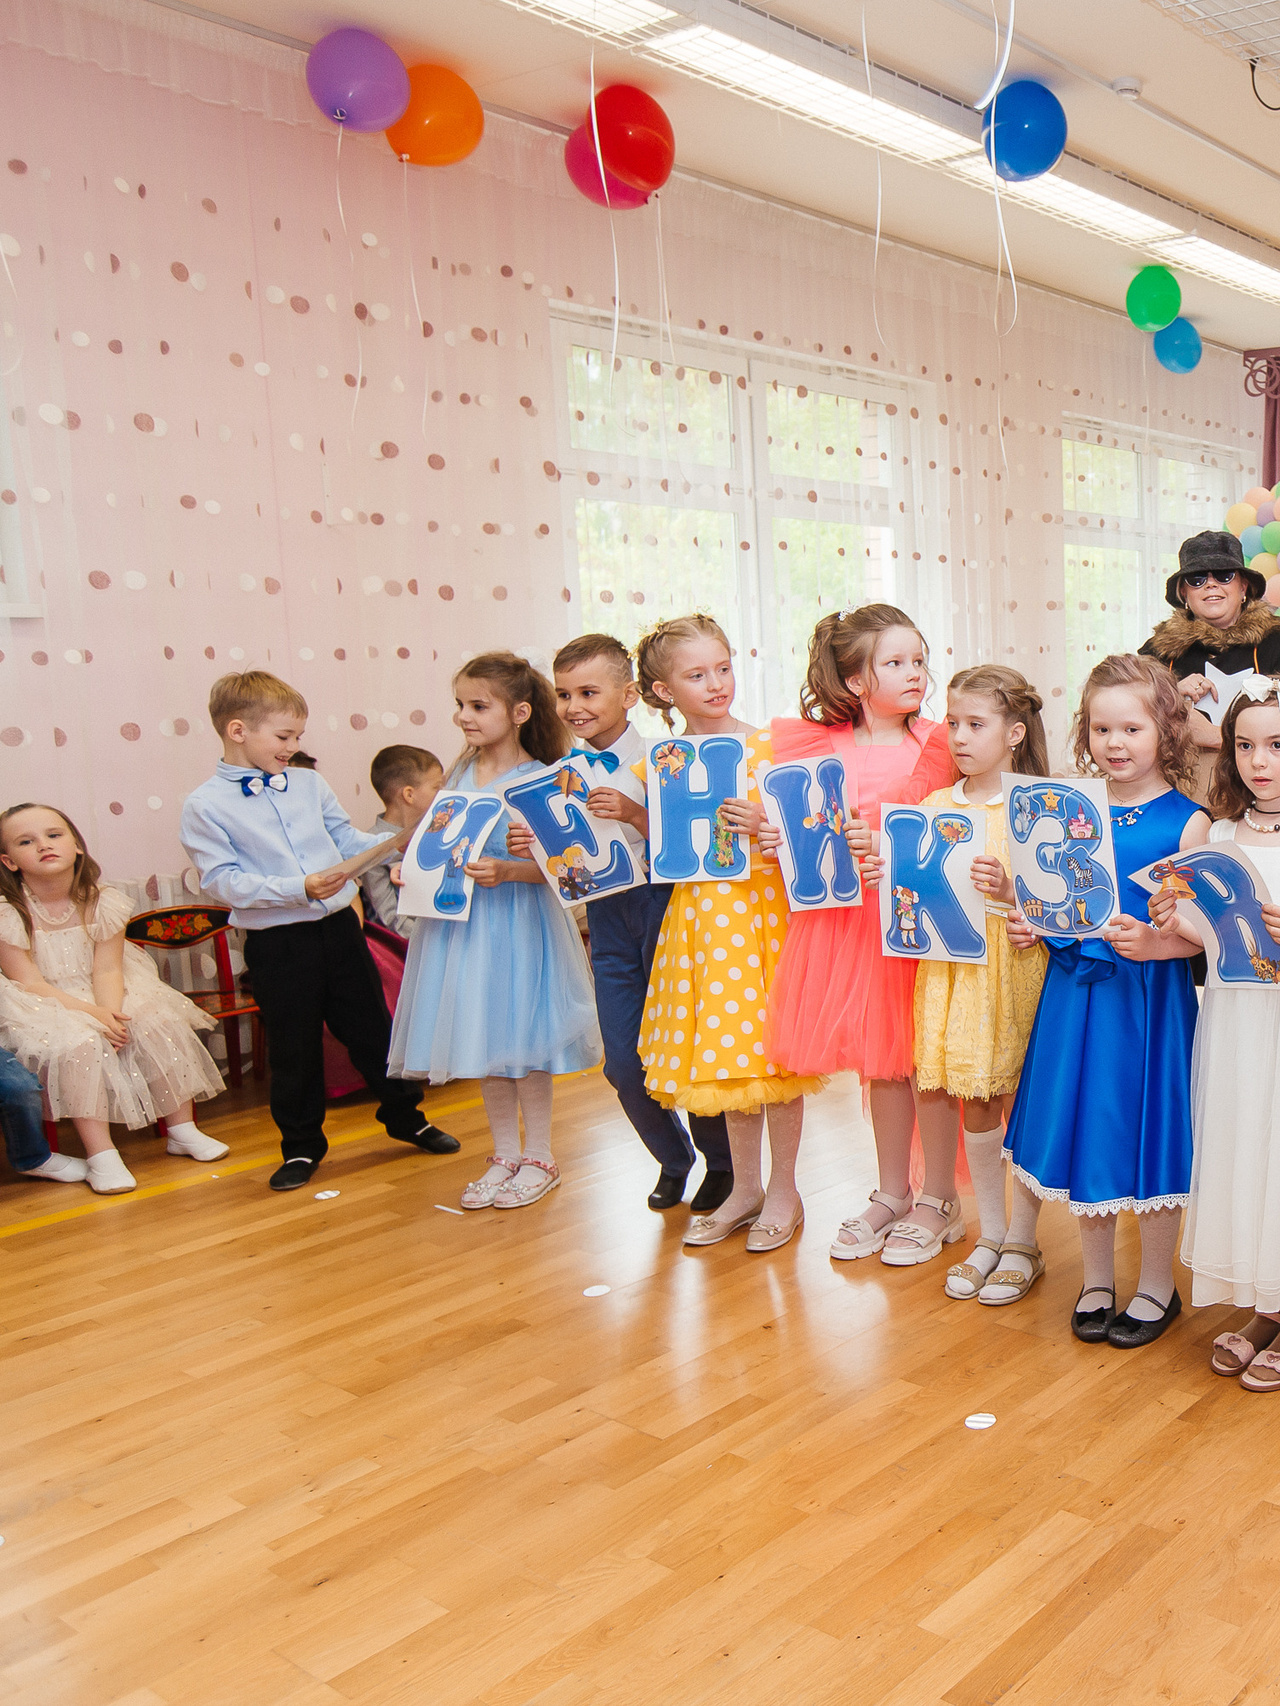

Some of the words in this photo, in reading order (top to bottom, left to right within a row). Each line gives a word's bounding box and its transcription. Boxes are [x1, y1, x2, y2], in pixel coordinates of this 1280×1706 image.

[416, 795, 502, 915] Ч
[504, 764, 634, 897] Е
[650, 737, 746, 879] Н
[763, 758, 858, 903] И
[884, 809, 985, 958] К
